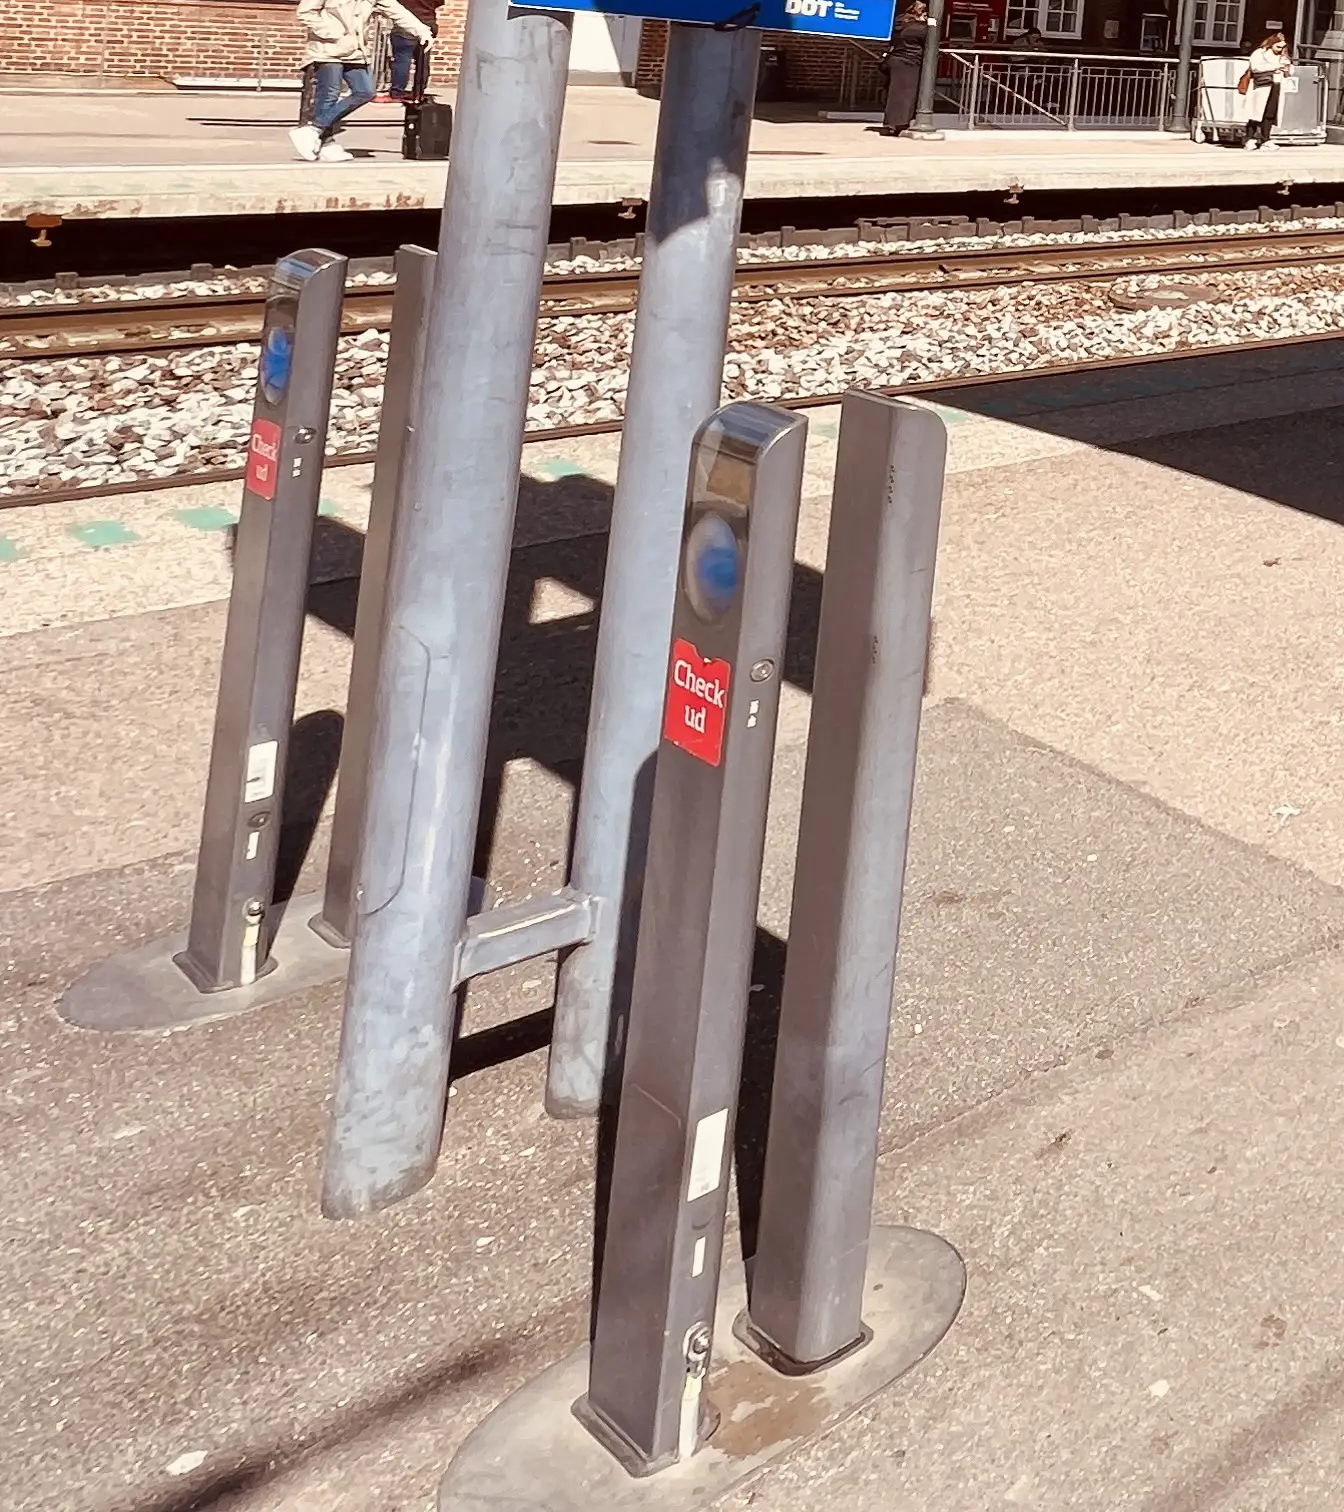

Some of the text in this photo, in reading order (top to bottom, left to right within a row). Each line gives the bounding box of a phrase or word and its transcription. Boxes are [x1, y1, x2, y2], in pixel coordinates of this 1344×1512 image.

[252, 433, 279, 463] Check
[255, 463, 269, 482] ud
[674, 659, 725, 709] Check
[685, 705, 706, 733] ud
